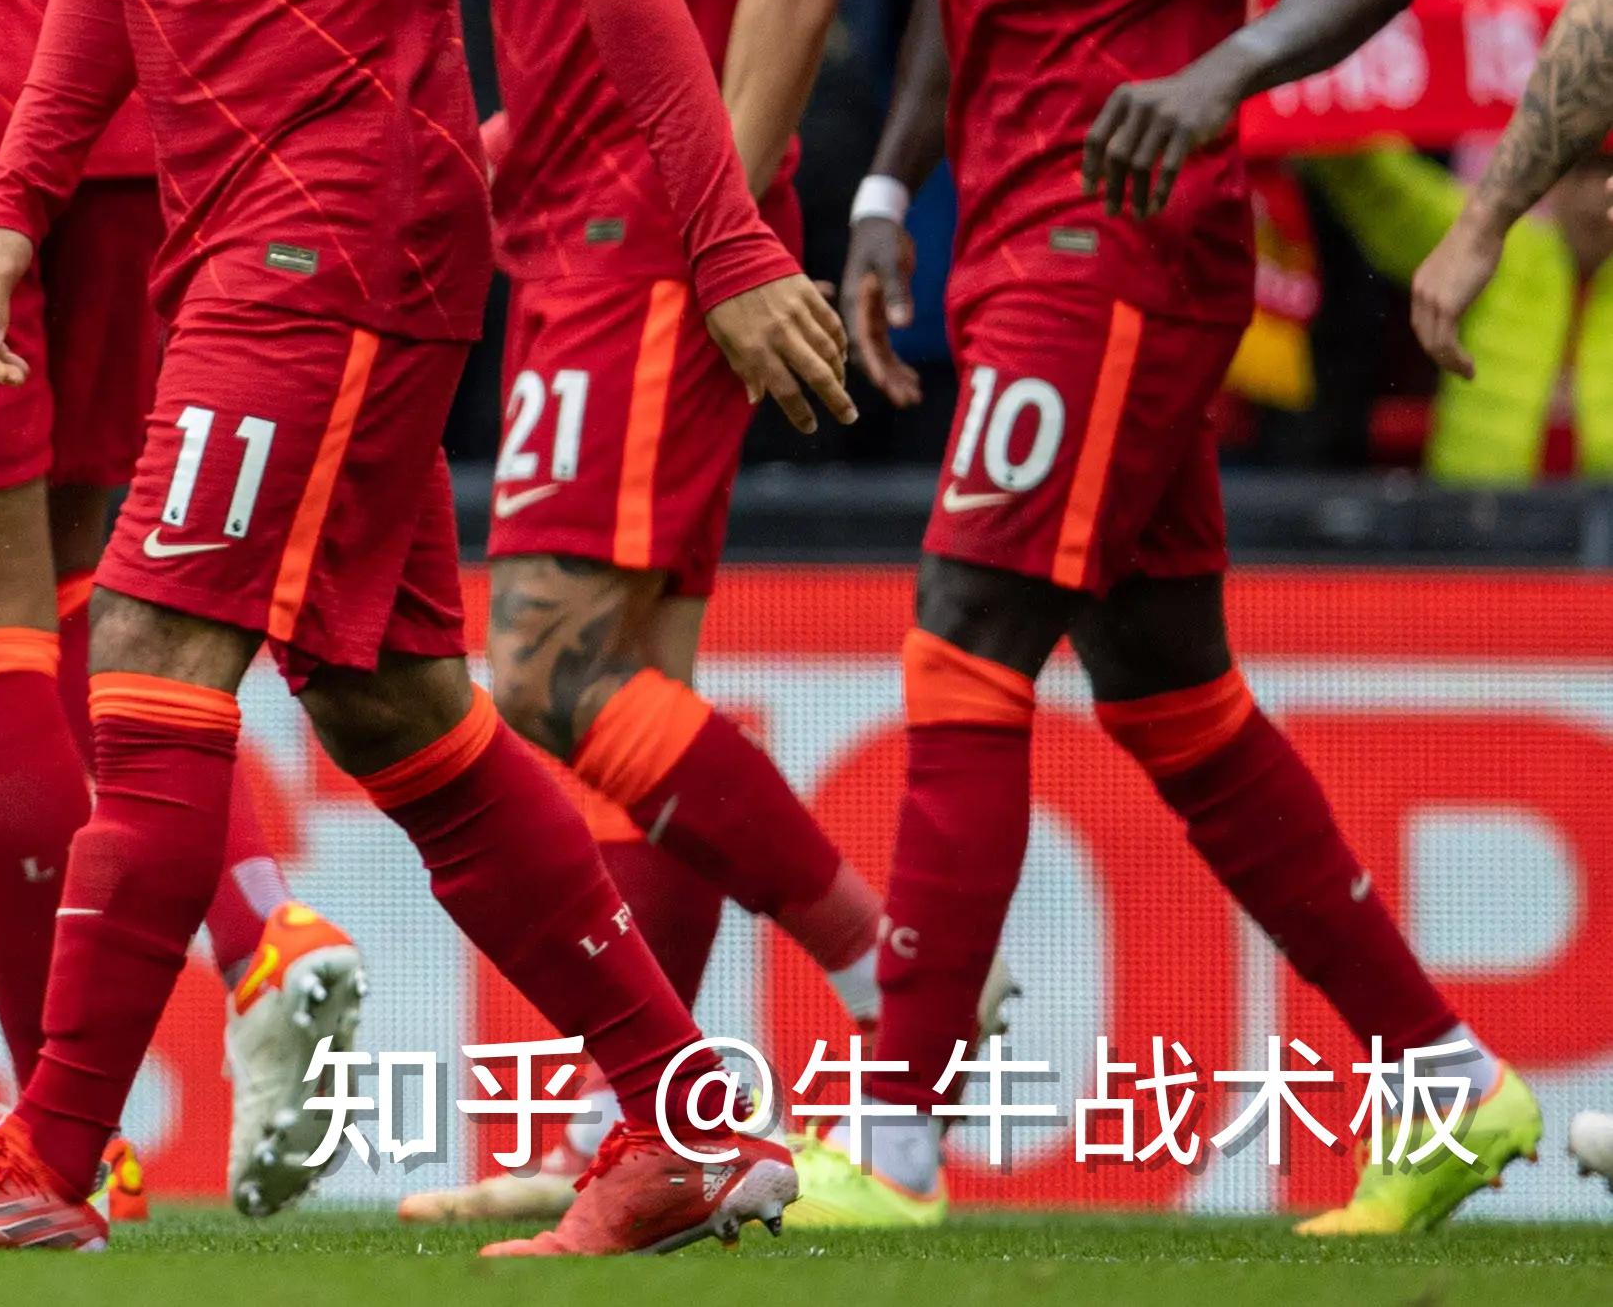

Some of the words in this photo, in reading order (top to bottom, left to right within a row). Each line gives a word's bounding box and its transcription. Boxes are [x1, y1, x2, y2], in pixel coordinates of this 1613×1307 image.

[162, 405, 278, 539] 11
[496, 369, 591, 482] 21
[950, 365, 1065, 492] 10
